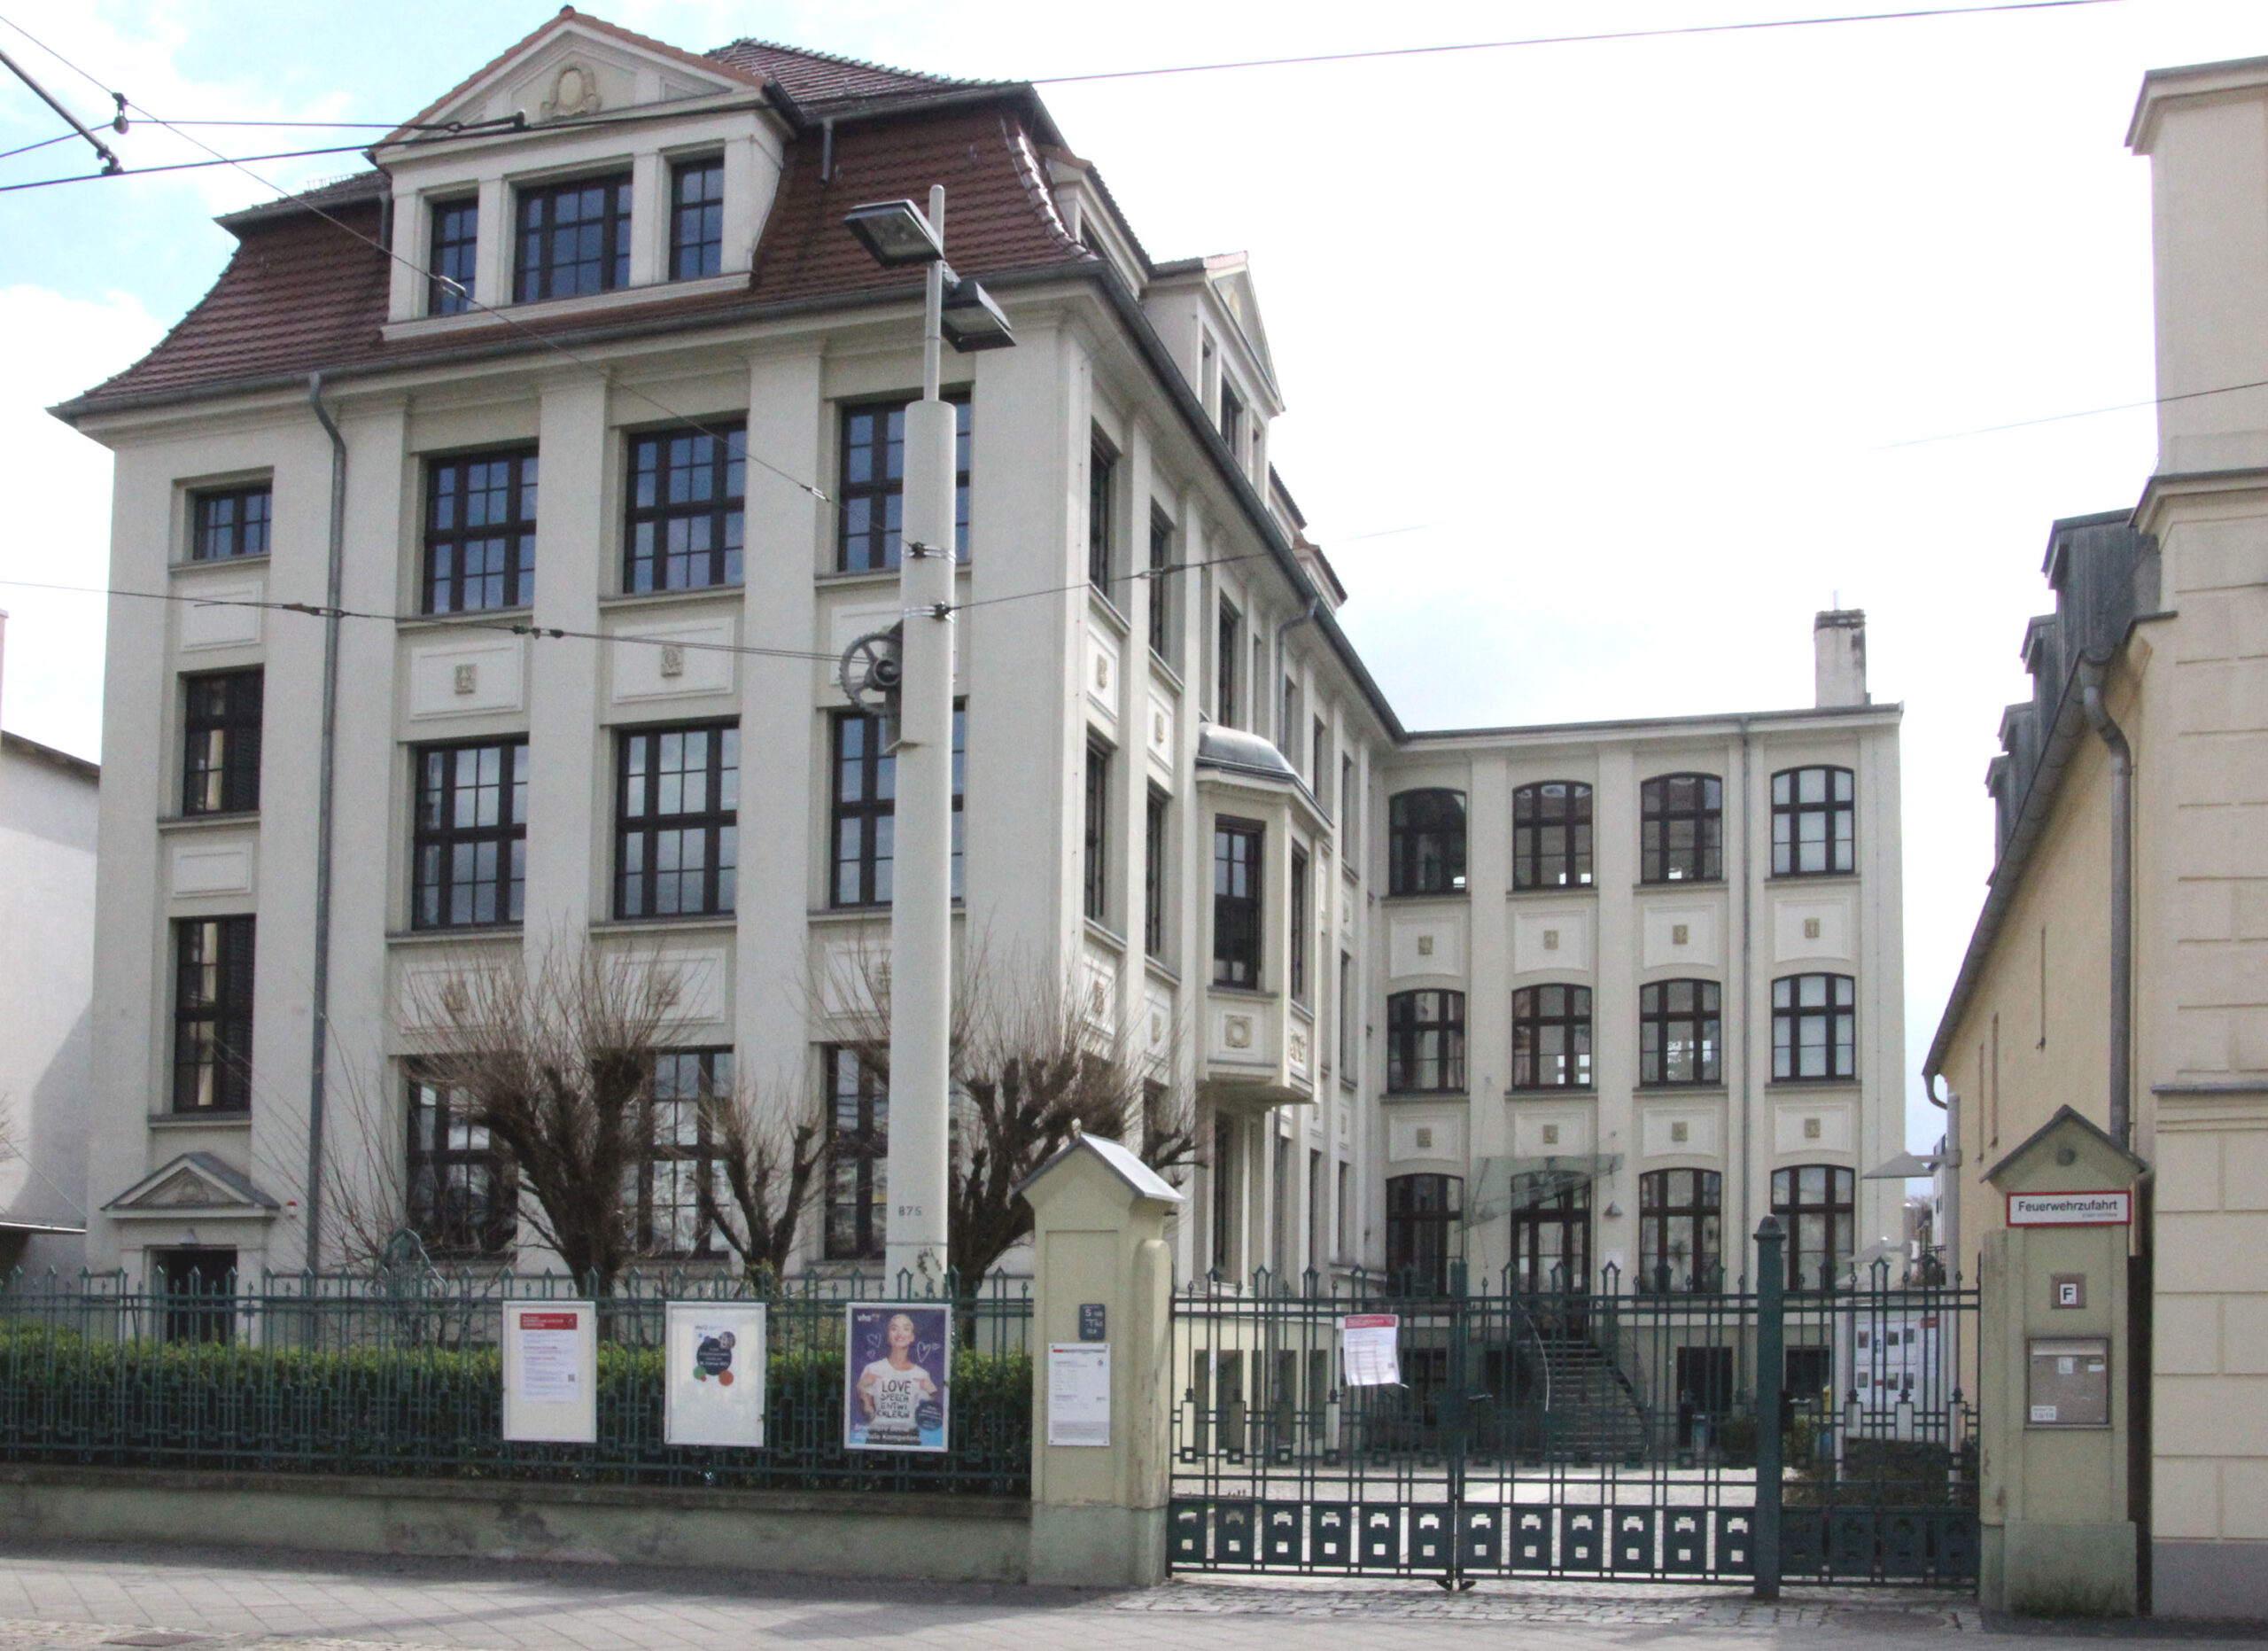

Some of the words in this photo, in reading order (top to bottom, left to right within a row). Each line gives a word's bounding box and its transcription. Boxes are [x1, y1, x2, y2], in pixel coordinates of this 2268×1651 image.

[2018, 1200, 2117, 1211] Feuerwehrzufahrt
[2063, 1288, 2073, 1300] F
[882, 1380, 912, 1395] LOVE
